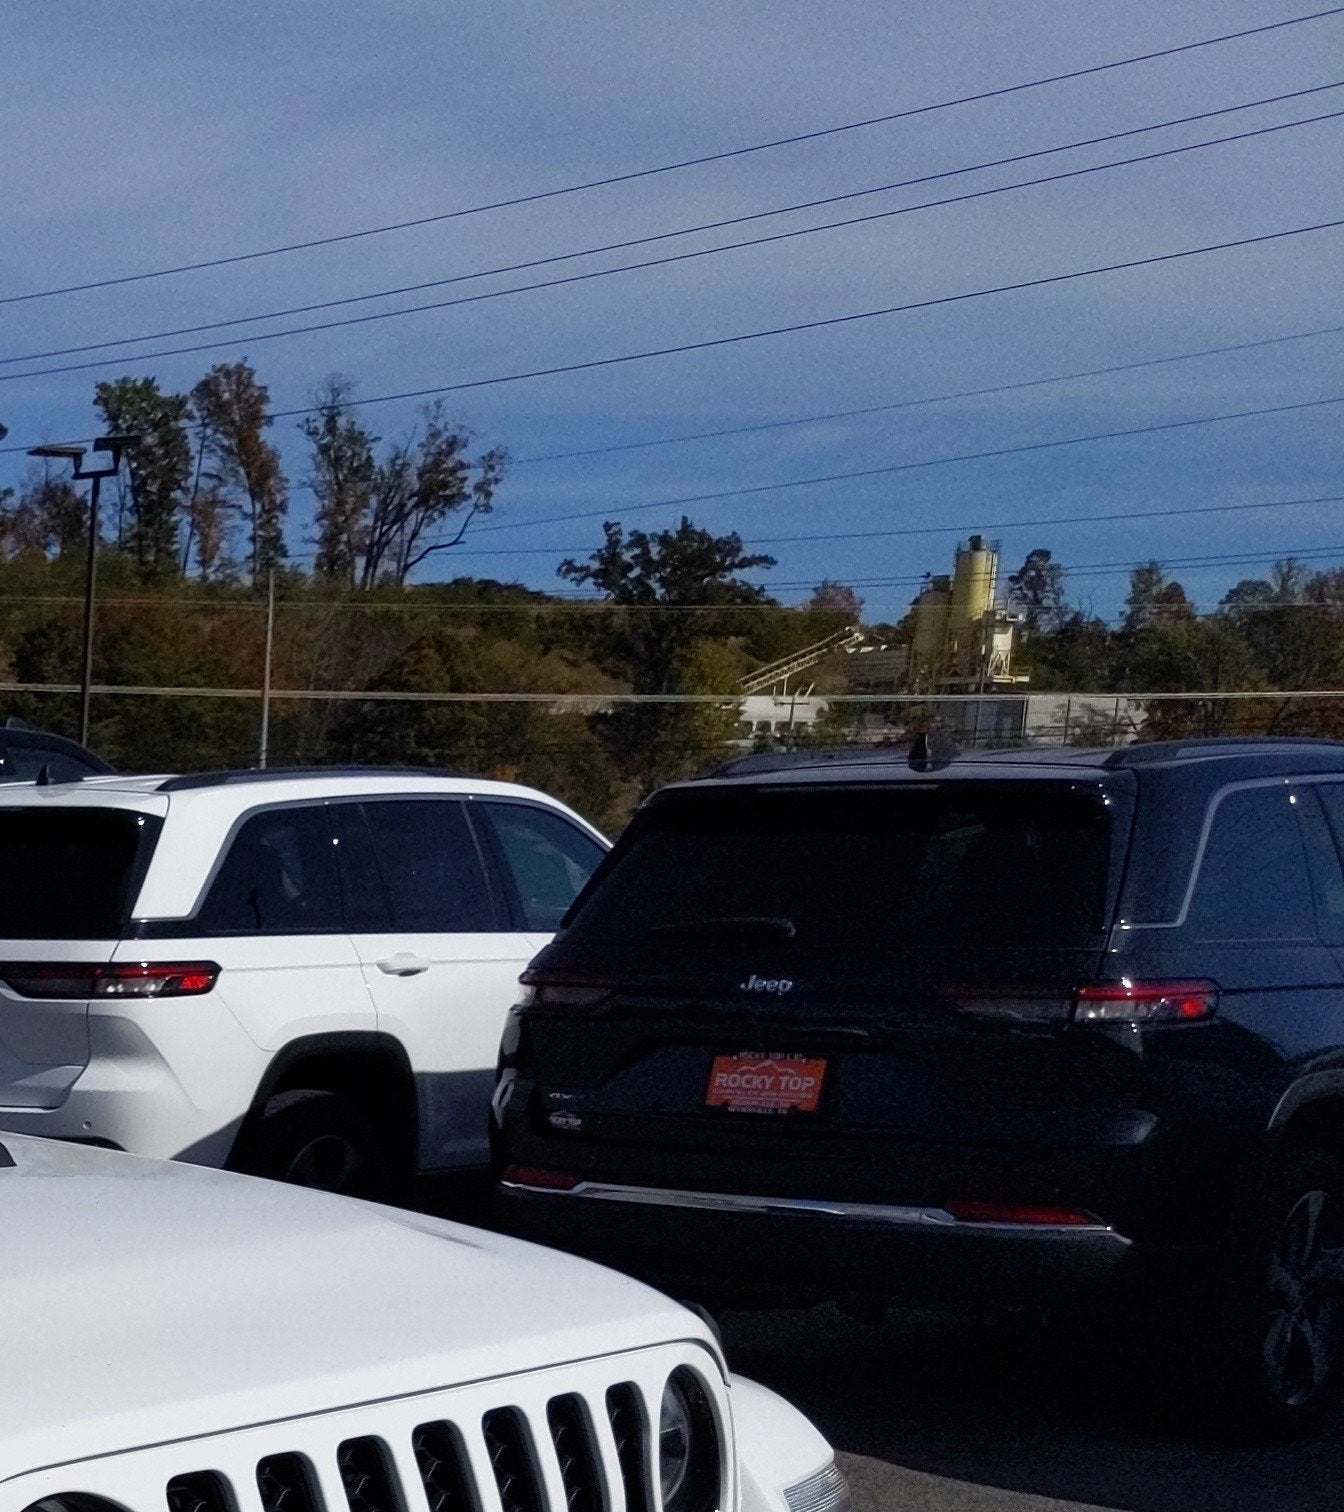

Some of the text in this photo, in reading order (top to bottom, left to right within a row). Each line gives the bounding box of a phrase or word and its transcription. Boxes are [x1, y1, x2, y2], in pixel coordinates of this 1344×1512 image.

[740, 974, 793, 996] Jeep
[715, 1072, 815, 1092] ROCKY TOP
